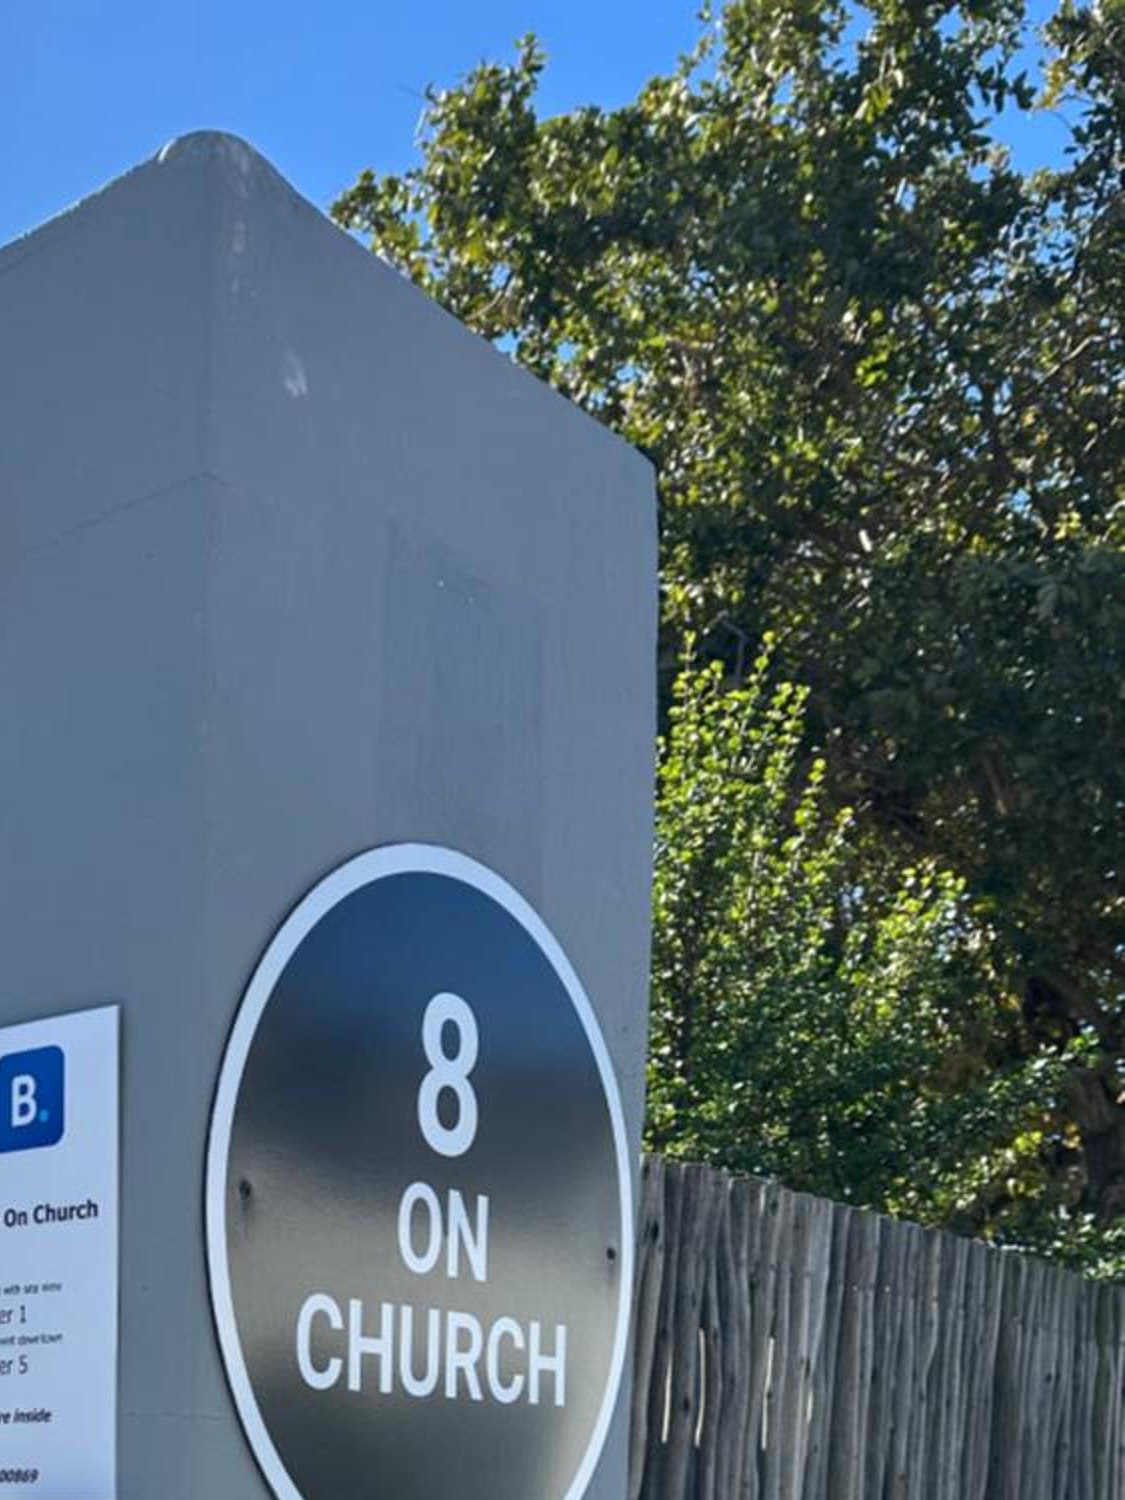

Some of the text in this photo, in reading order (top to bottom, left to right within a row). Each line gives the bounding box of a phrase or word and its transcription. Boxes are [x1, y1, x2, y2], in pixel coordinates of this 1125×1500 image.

[417, 992, 479, 1158] 8
[4, 1208, 28, 1228] On
[33, 1199, 99, 1224] Church
[398, 1182, 490, 1282] ON
[19, 1305, 27, 1324] 1
[296, 1293, 567, 1406] CHURCH
[18, 1355, 28, 1375] 5
[13, 1408, 53, 1424] inside
